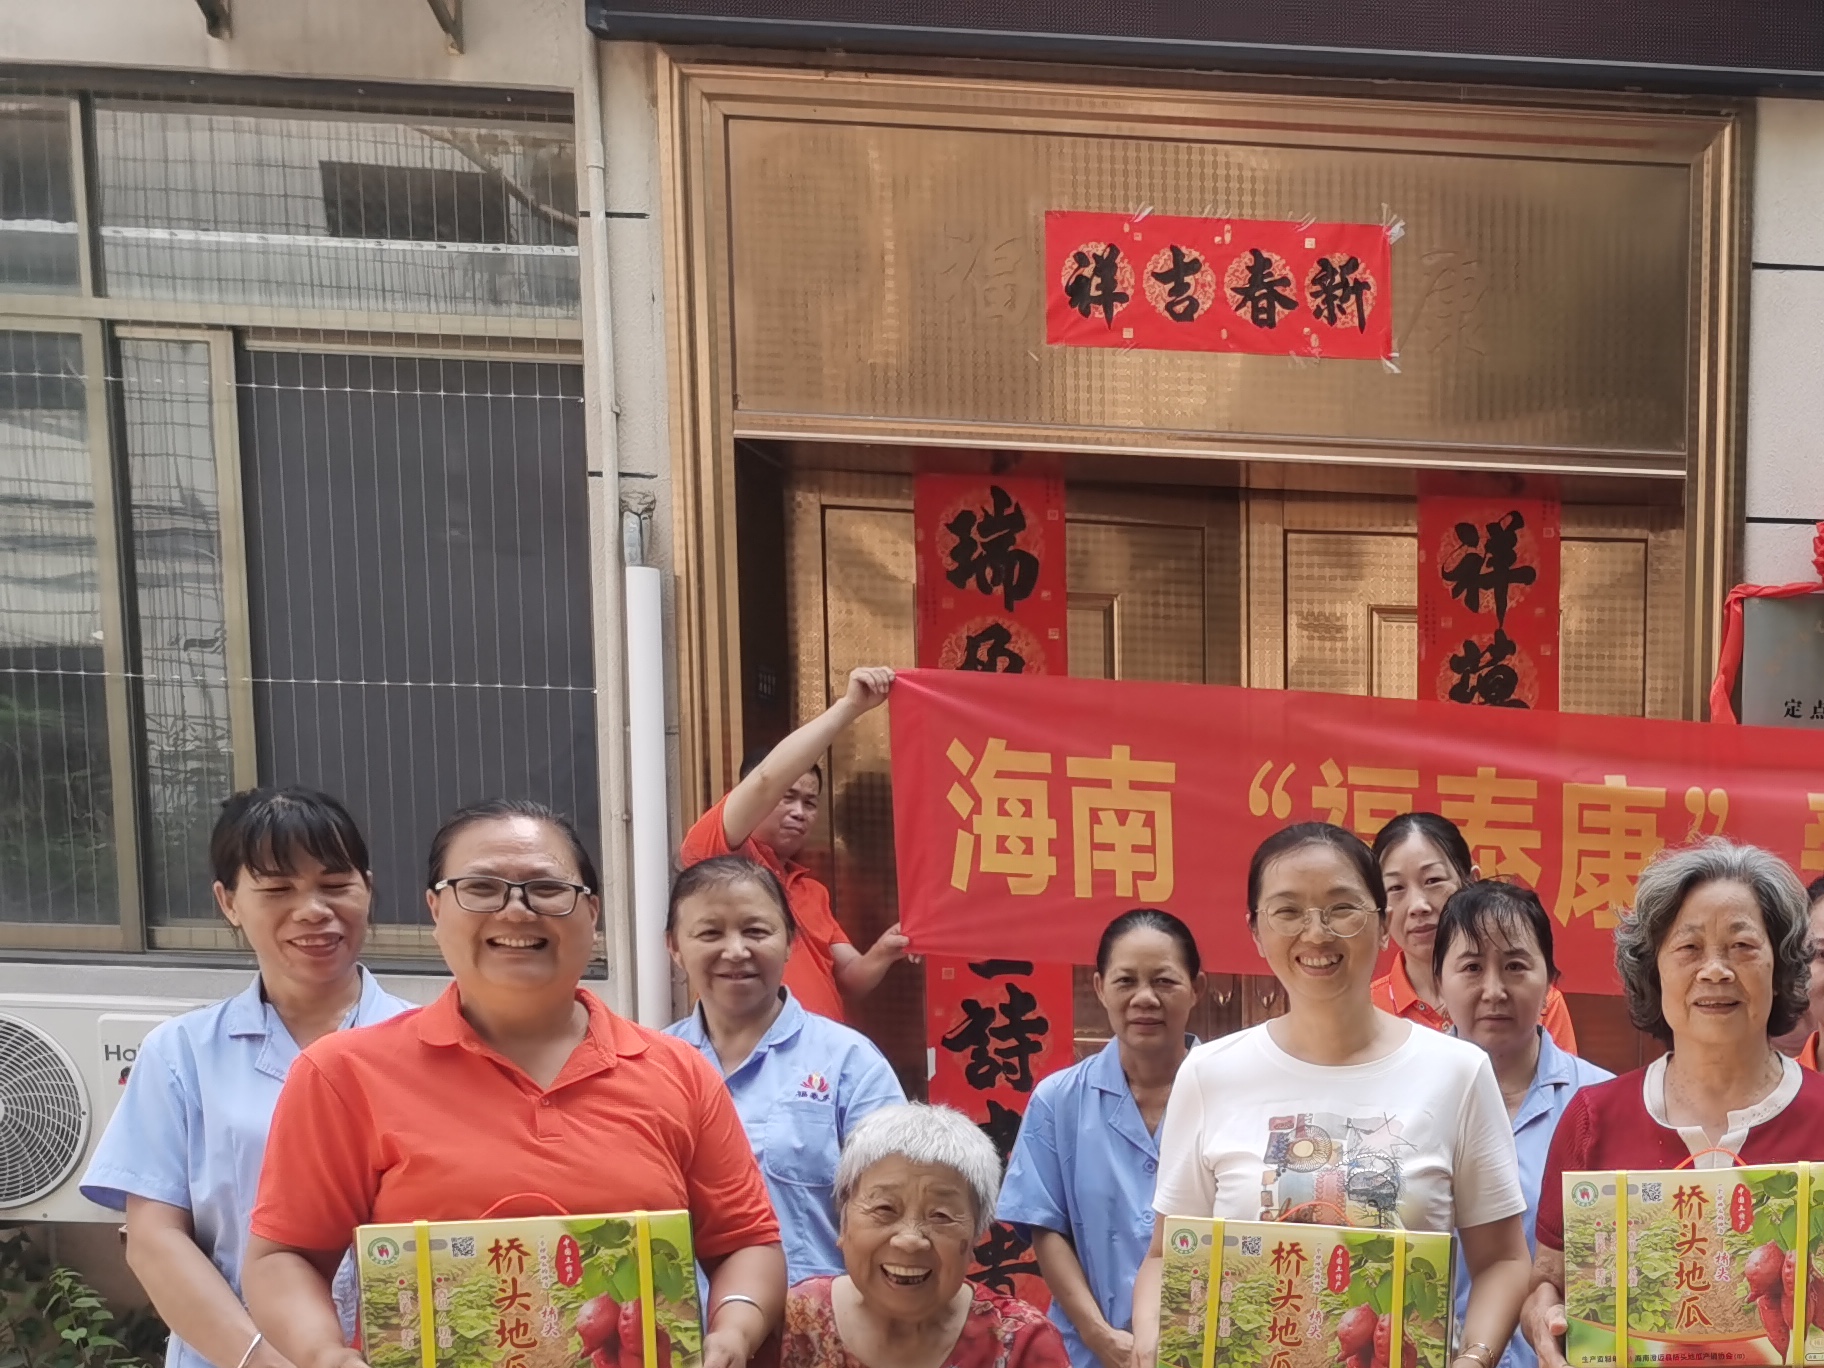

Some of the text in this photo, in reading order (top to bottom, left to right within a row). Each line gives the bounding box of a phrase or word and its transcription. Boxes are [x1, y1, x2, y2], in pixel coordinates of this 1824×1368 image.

[1738, 1186, 1746, 1229] 中国土特产
[1334, 1247, 1343, 1290] 中国土特产
[1671, 1184, 1712, 1329] 桥头地瓜
